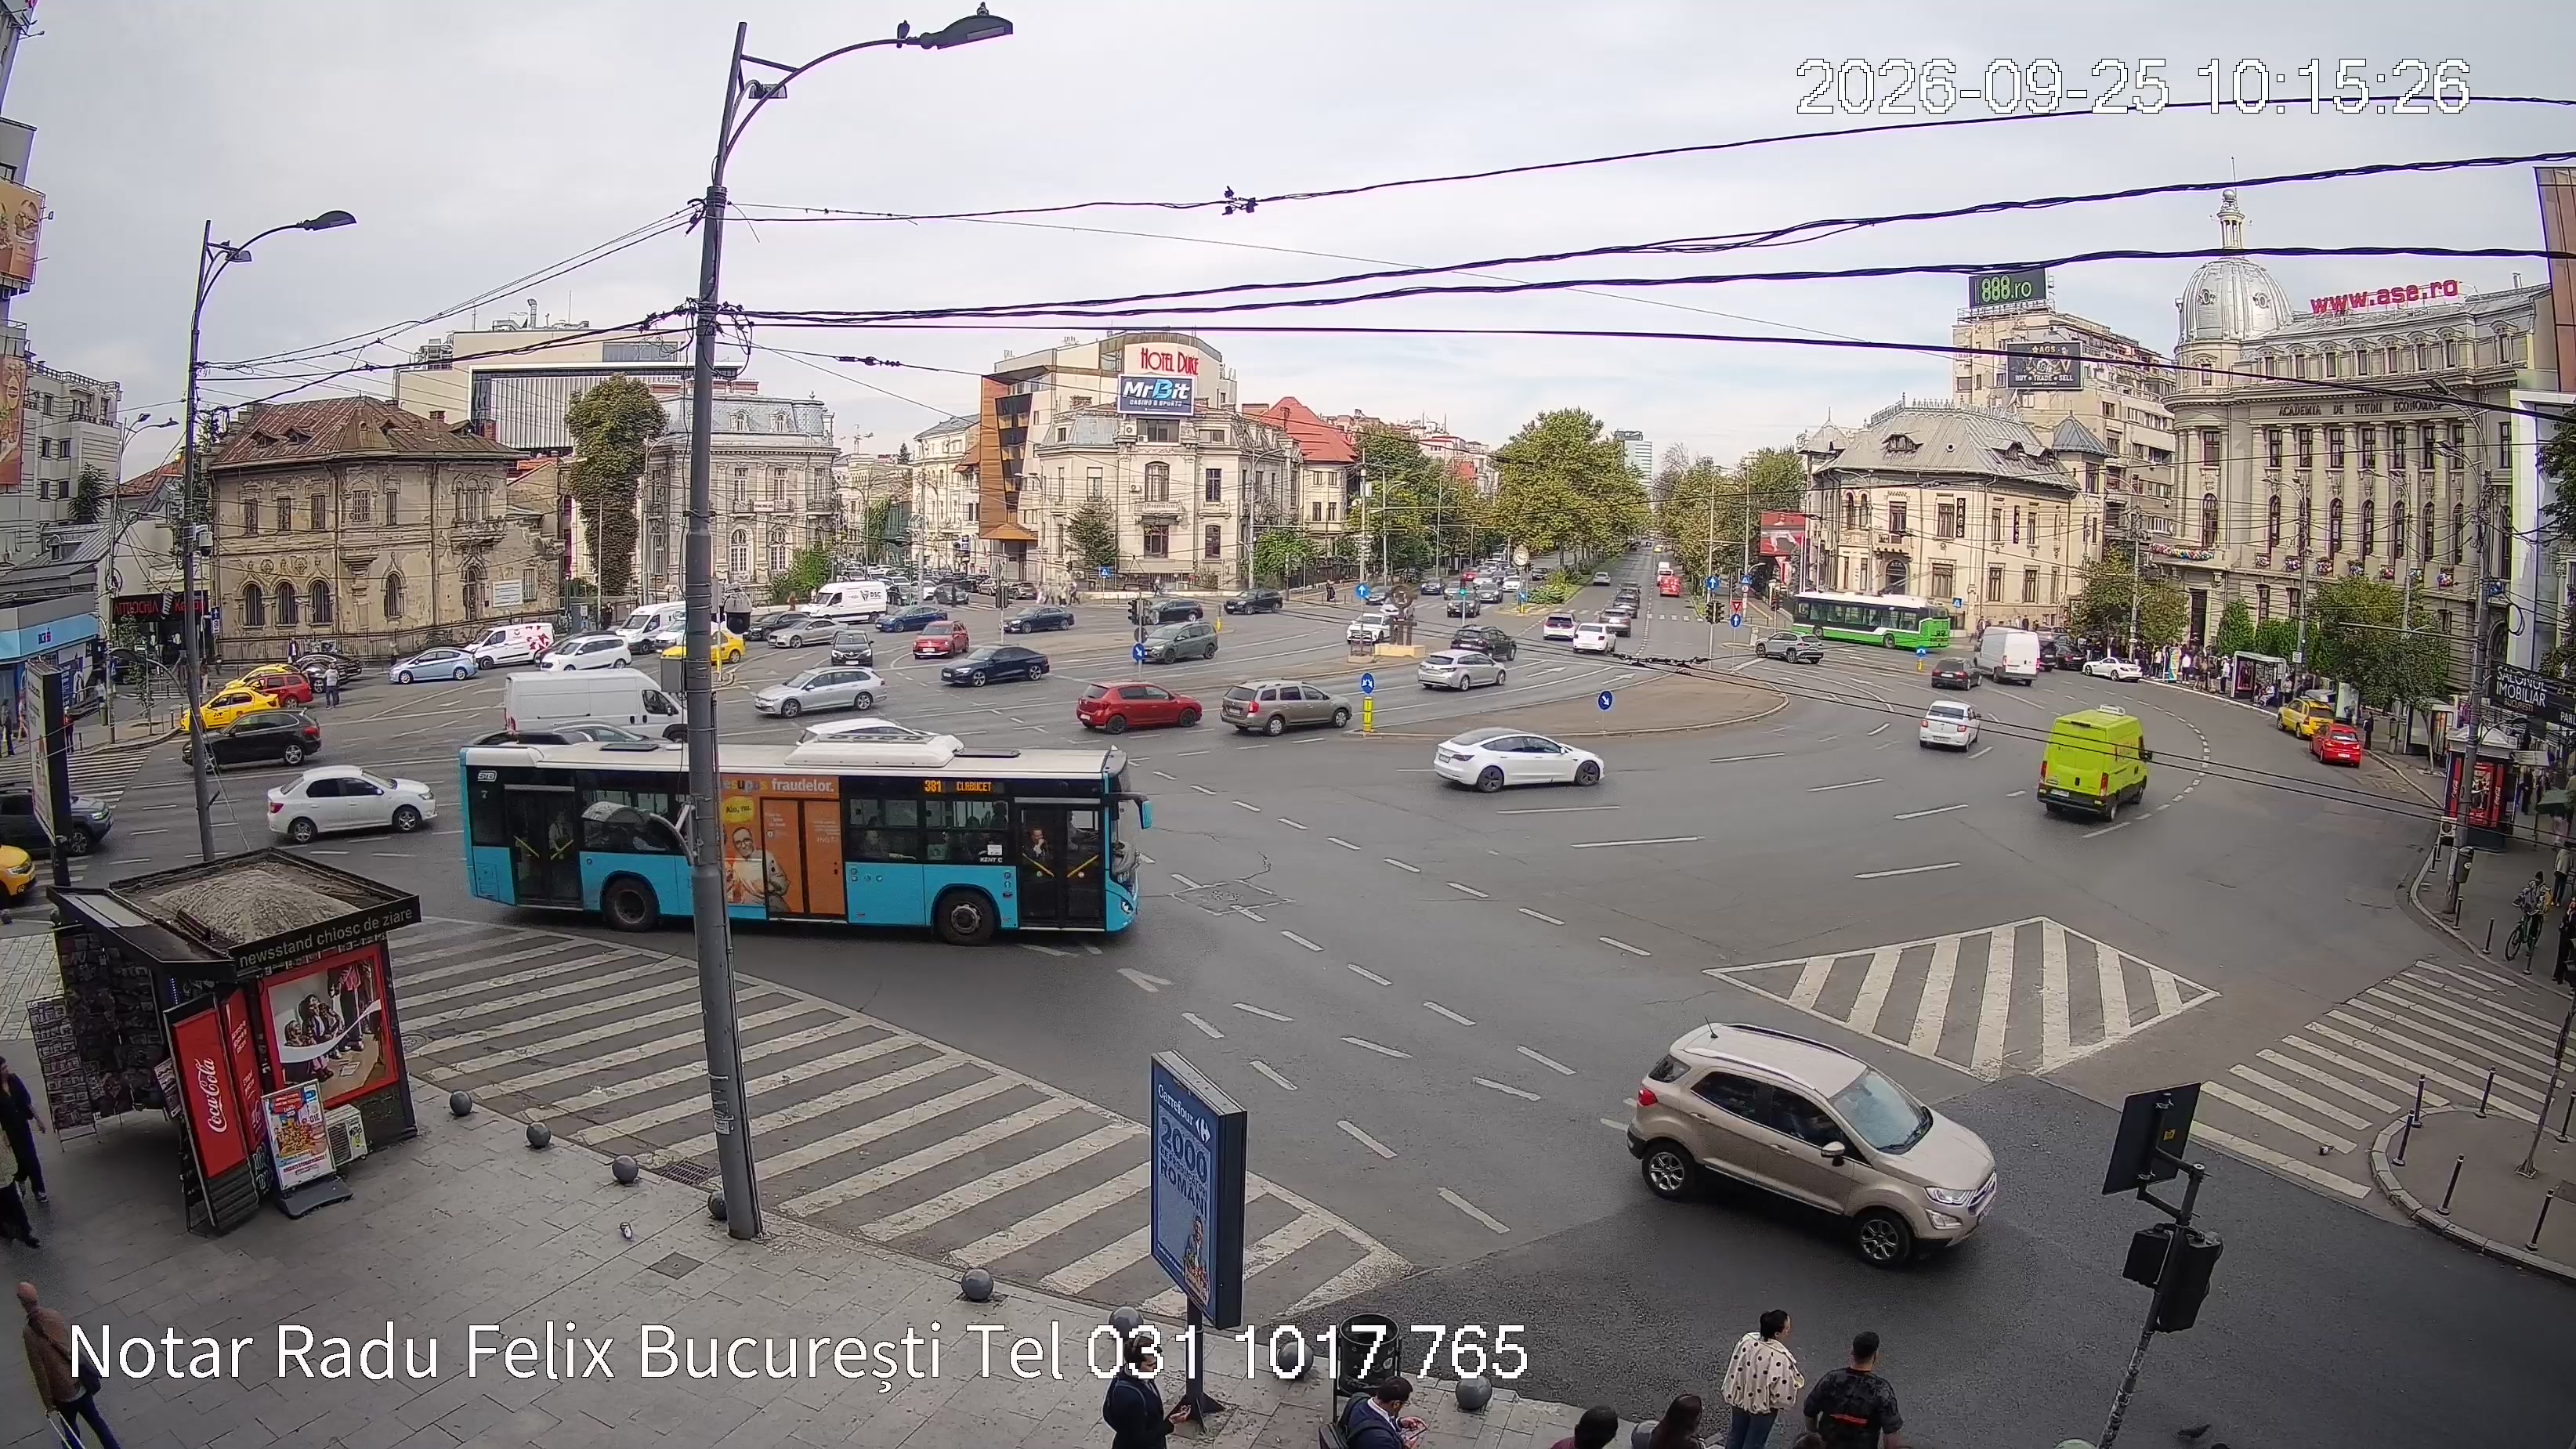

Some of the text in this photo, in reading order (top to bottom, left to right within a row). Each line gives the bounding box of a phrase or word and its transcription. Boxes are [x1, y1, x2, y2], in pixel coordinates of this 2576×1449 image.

[1981, 275, 2031, 302] 888.ro
[2311, 280, 2458, 314] www.ase.ro
[1141, 347, 1199, 375] HOTEL DUKE
[1122, 379, 1191, 400] MrBit
[2279, 404, 2321, 416] ACADEMIA
[2333, 404, 2344, 415] DE
[2354, 403, 2382, 414] STUDII
[2497, 666, 2547, 692] SALONUL
[2496, 681, 2545, 708] IMOBILIAR
[772, 778, 834, 793] fraudelor.
[924, 780, 941, 792] 381
[240, 909, 412, 968] newsstand chiosc de ziare
[1158, 1084, 1194, 1126] Carrefour
[1160, 1117, 1207, 1183] 2000
